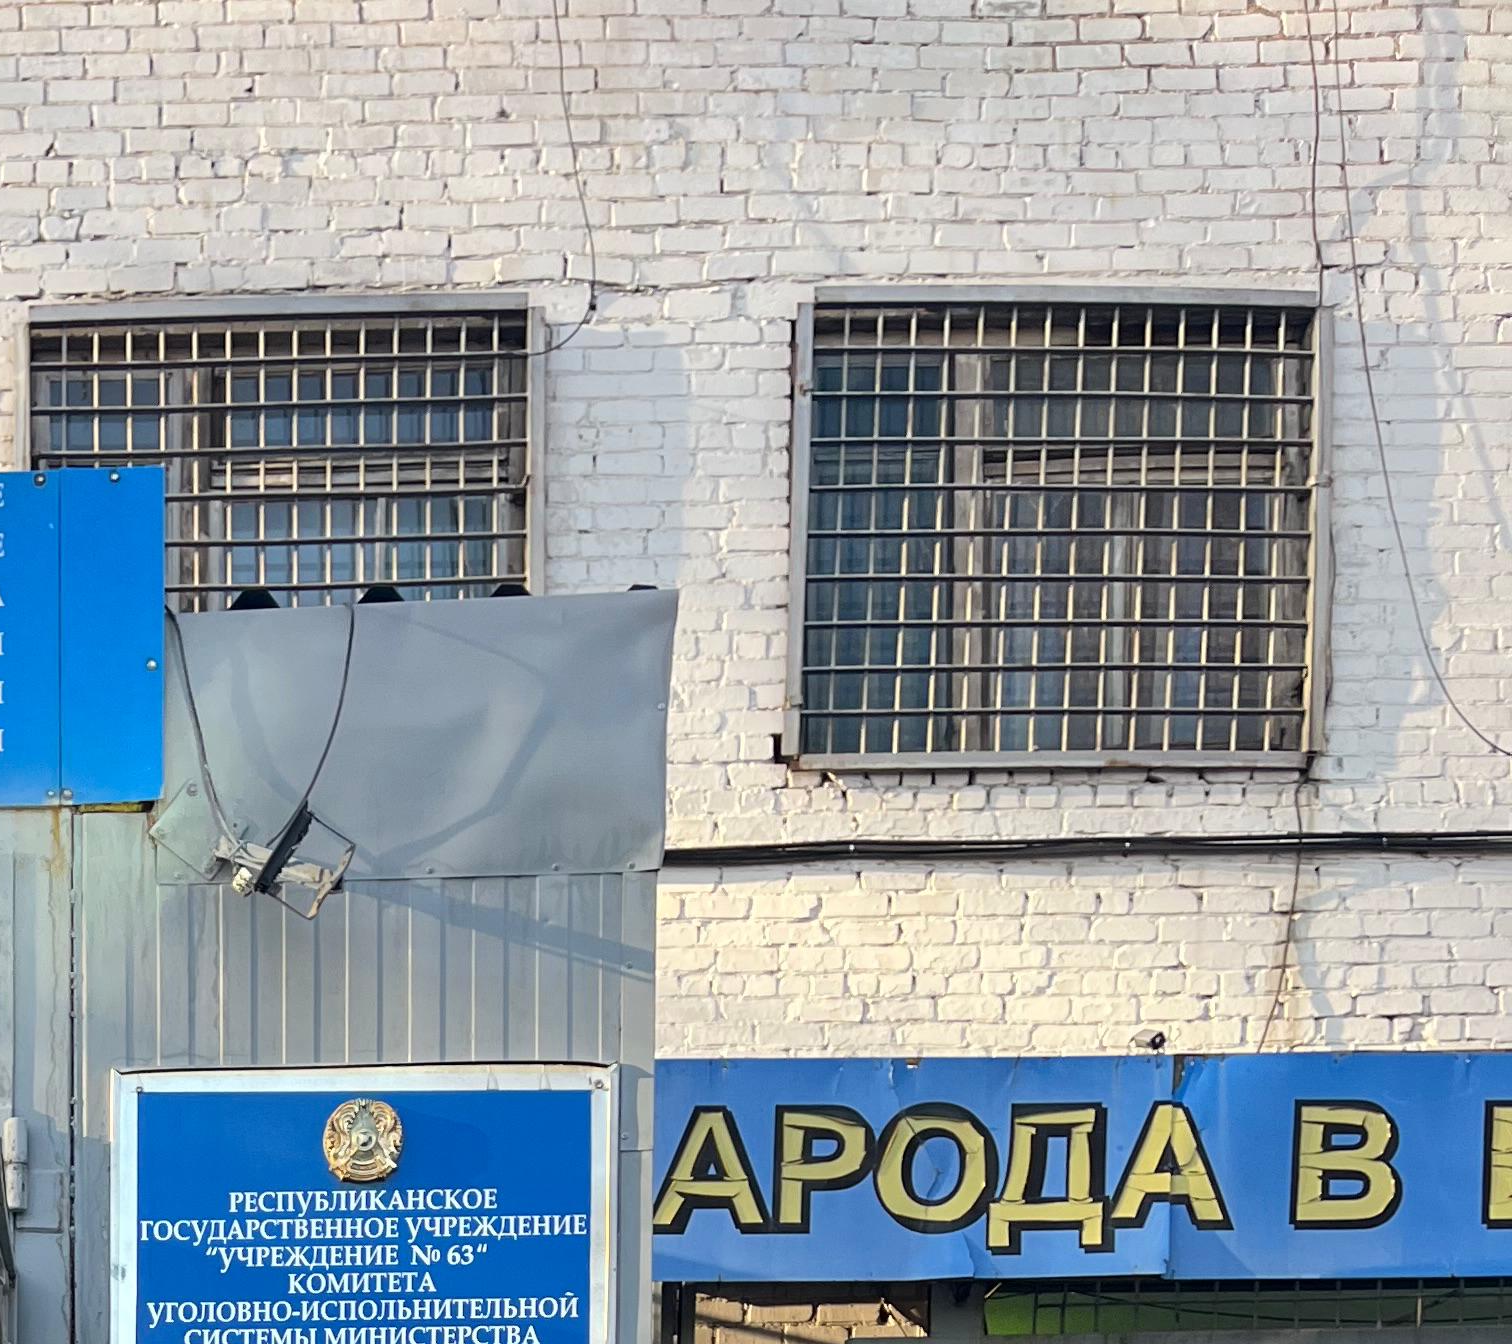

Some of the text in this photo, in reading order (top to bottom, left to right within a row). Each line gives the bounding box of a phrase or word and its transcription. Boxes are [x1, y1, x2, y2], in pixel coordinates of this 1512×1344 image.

[1290, 1099, 1403, 1229] В
[229, 1188, 498, 1217] РЕСПУБЛИКАНСКОЕ
[140, 1214, 587, 1246] ГОСУДАРСТВЕННОЕ УЧРЕЖДЕНИЕ
[410, 1244, 441, 1266] №
[287, 1271, 437, 1294] КОМИТЕТА
[146, 1291, 579, 1329] УГОЛОВНО-ИСПОЛЬНИТЕЛЬНОЙ
